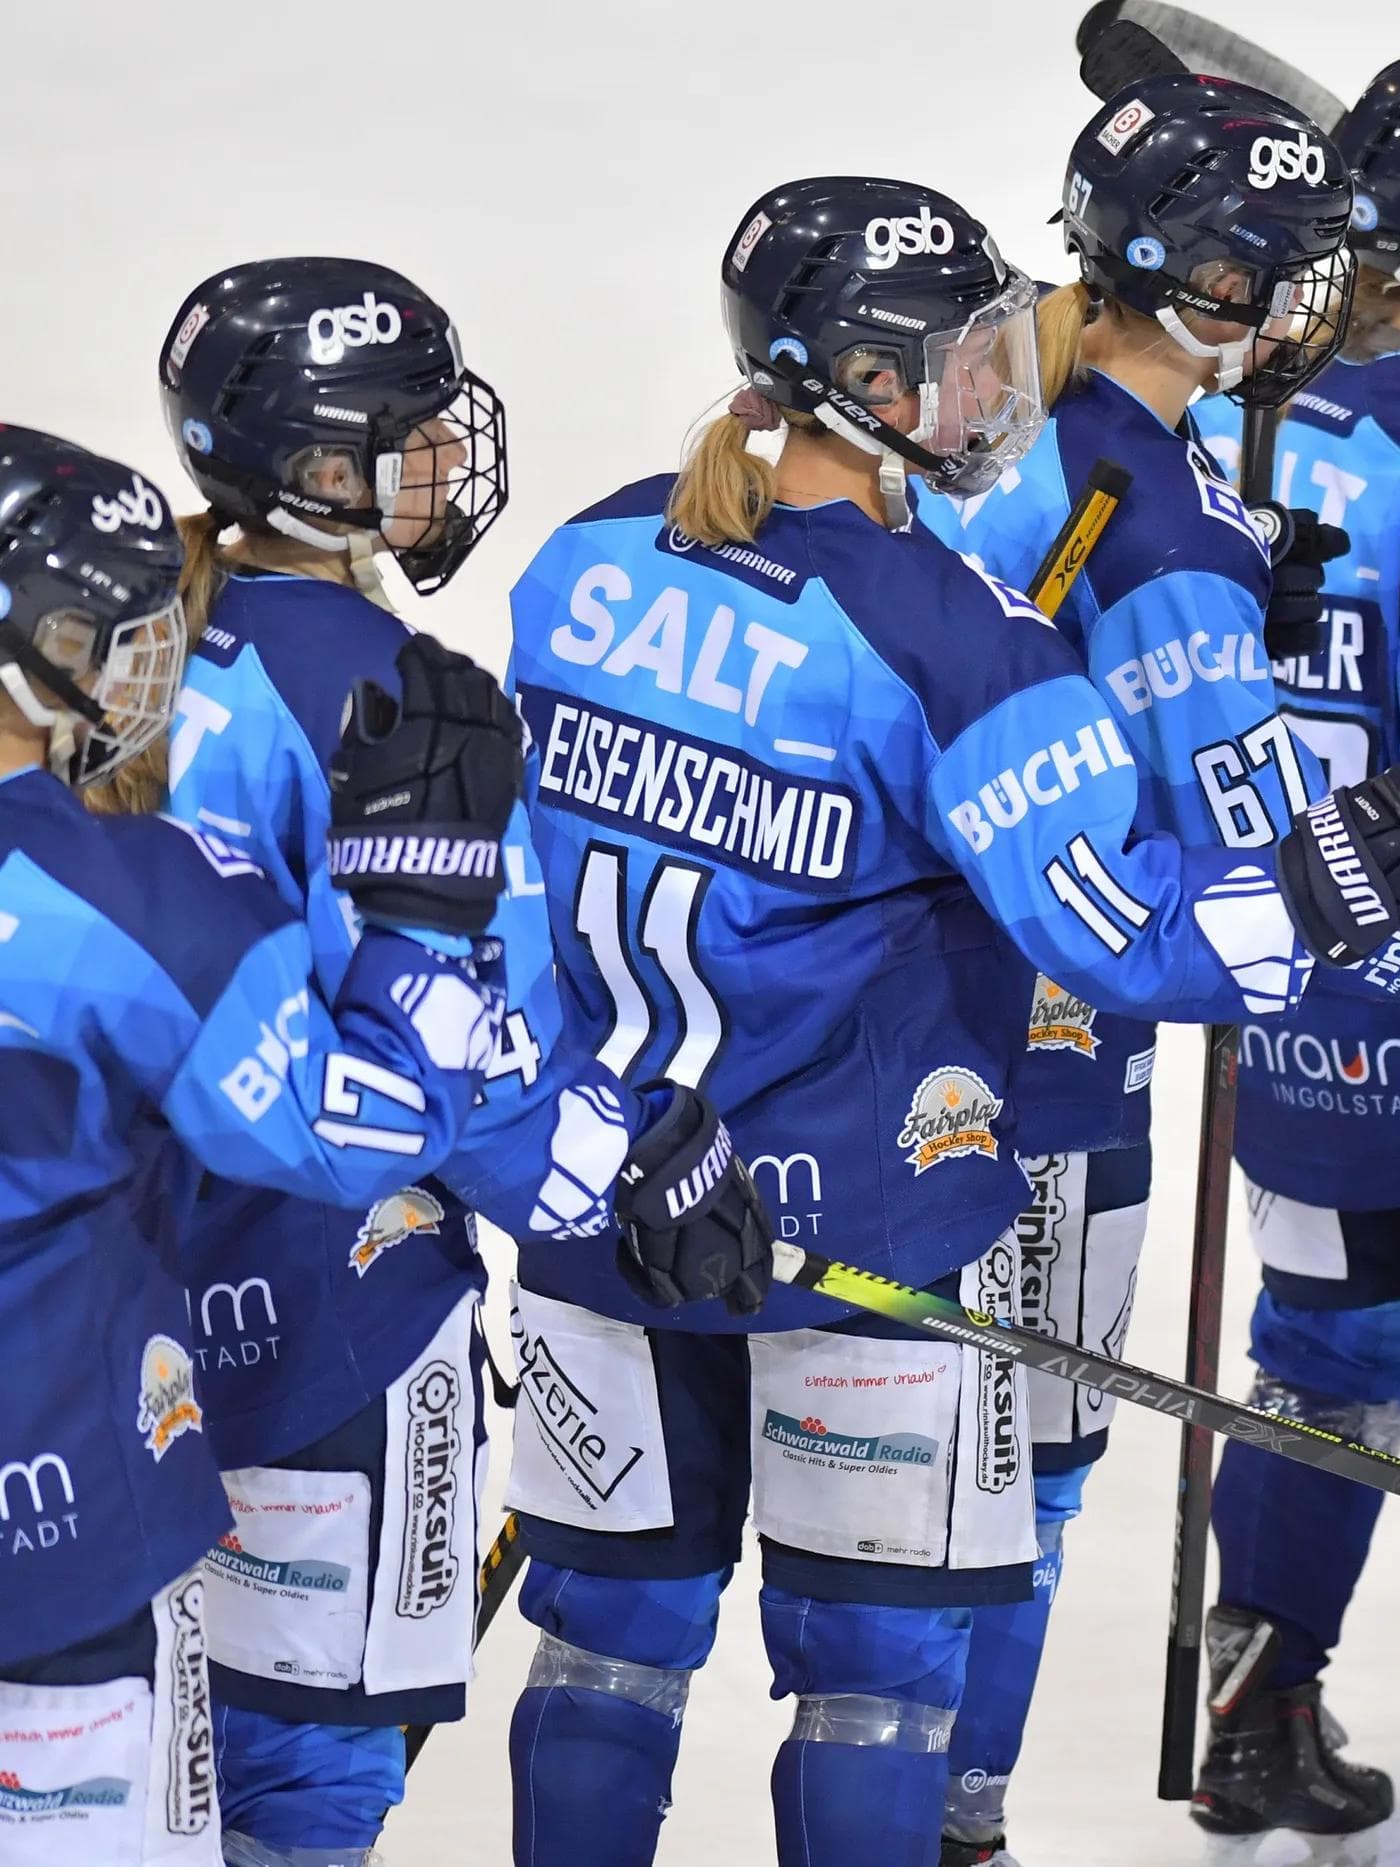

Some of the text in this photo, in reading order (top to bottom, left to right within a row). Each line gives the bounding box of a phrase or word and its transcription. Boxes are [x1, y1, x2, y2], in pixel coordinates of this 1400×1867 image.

[1248, 132, 1326, 189] gsb
[865, 206, 955, 270] gsb
[308, 291, 402, 365] gsb
[539, 702, 854, 881] EISENSCHMID
[1194, 714, 1310, 849] 67
[1044, 831, 1152, 958] 11
[575, 849, 723, 1093] 11
[1032, 997, 1094, 1026] irplay
[1030, 1030, 1058, 1042] ockey
[313, 1052, 427, 1156] 17
[900, 1098, 1002, 1146] Fairplay
[928, 1132, 988, 1153] Hockey Shop
[620, 1161, 646, 1187] 14
[922, 1316, 1023, 1357] WARRIOR
[804, 1375, 849, 1389] Einfach
[1037, 1355, 1199, 1421] ALPHA
[412, 1421, 426, 1490] HOCKEY
[765, 1421, 933, 1466] Schwarzwald Radio
[782, 1449, 899, 1476] Classic Hits & Super Oldies
[206, 1548, 345, 1593] warzwald Radio
[886, 1545, 909, 1557] mehr
[909, 1548, 932, 1558] radio
[225, 1572, 242, 1587] Hits
[252, 1582, 277, 1598] Super
[279, 1589, 310, 1603] Oldies
